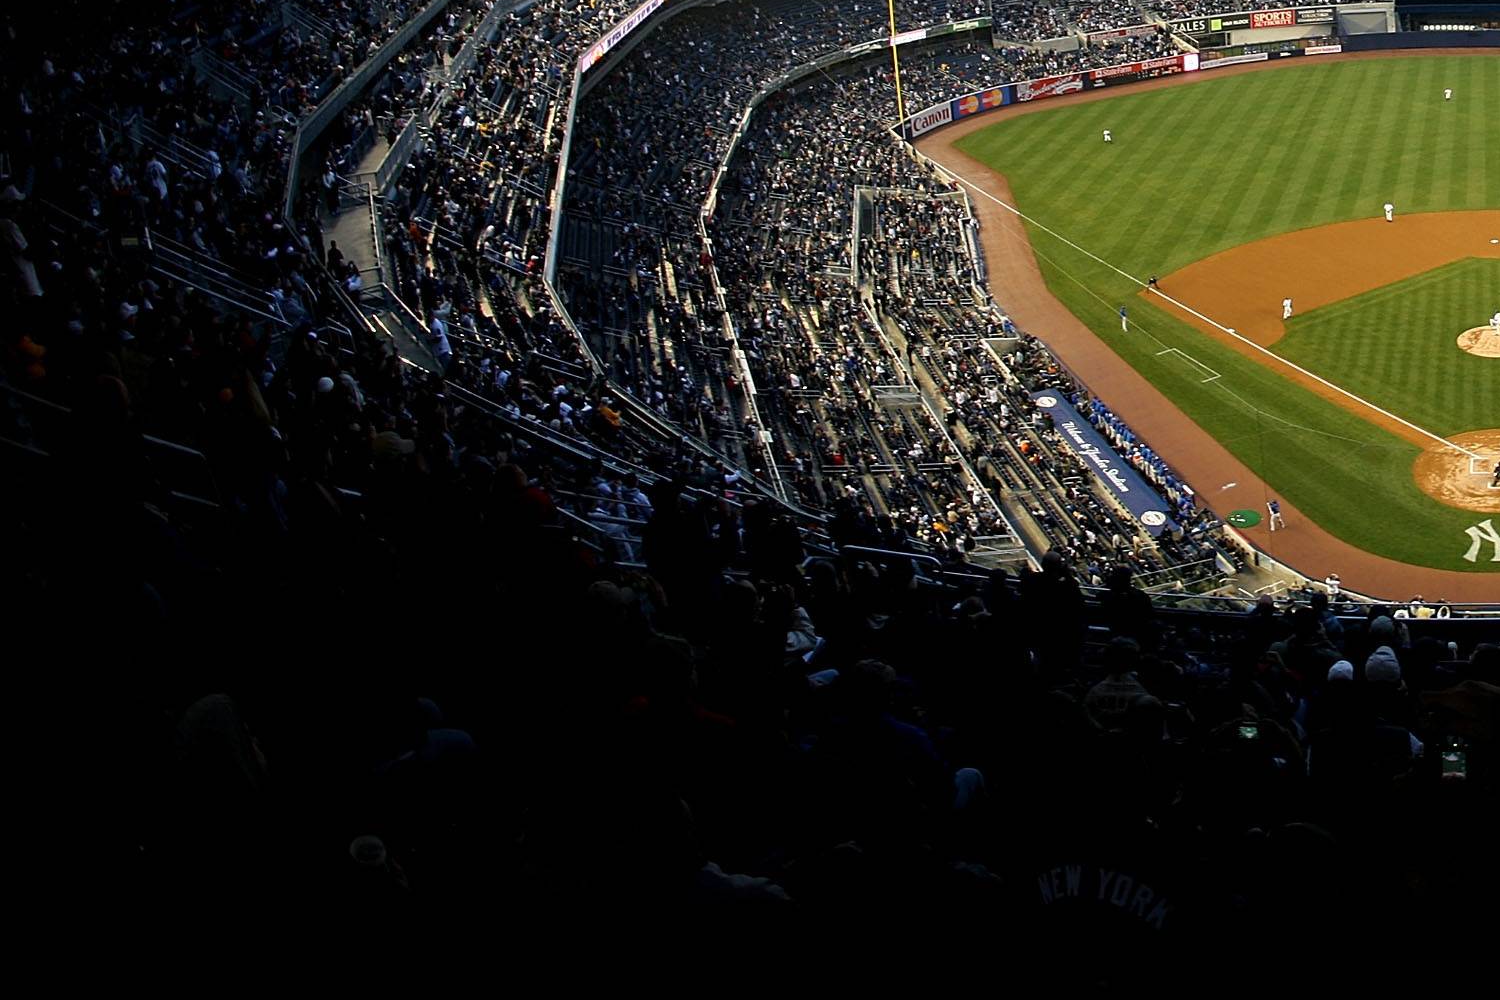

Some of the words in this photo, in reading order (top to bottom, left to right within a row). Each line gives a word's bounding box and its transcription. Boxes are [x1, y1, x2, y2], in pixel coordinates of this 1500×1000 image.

[1254, 11, 1292, 22] SPORTS
[1173, 20, 1206, 33] ZALES
[913, 107, 950, 132] Canon
[1037, 864, 1083, 904] NEW
[1097, 867, 1168, 931] YORK
